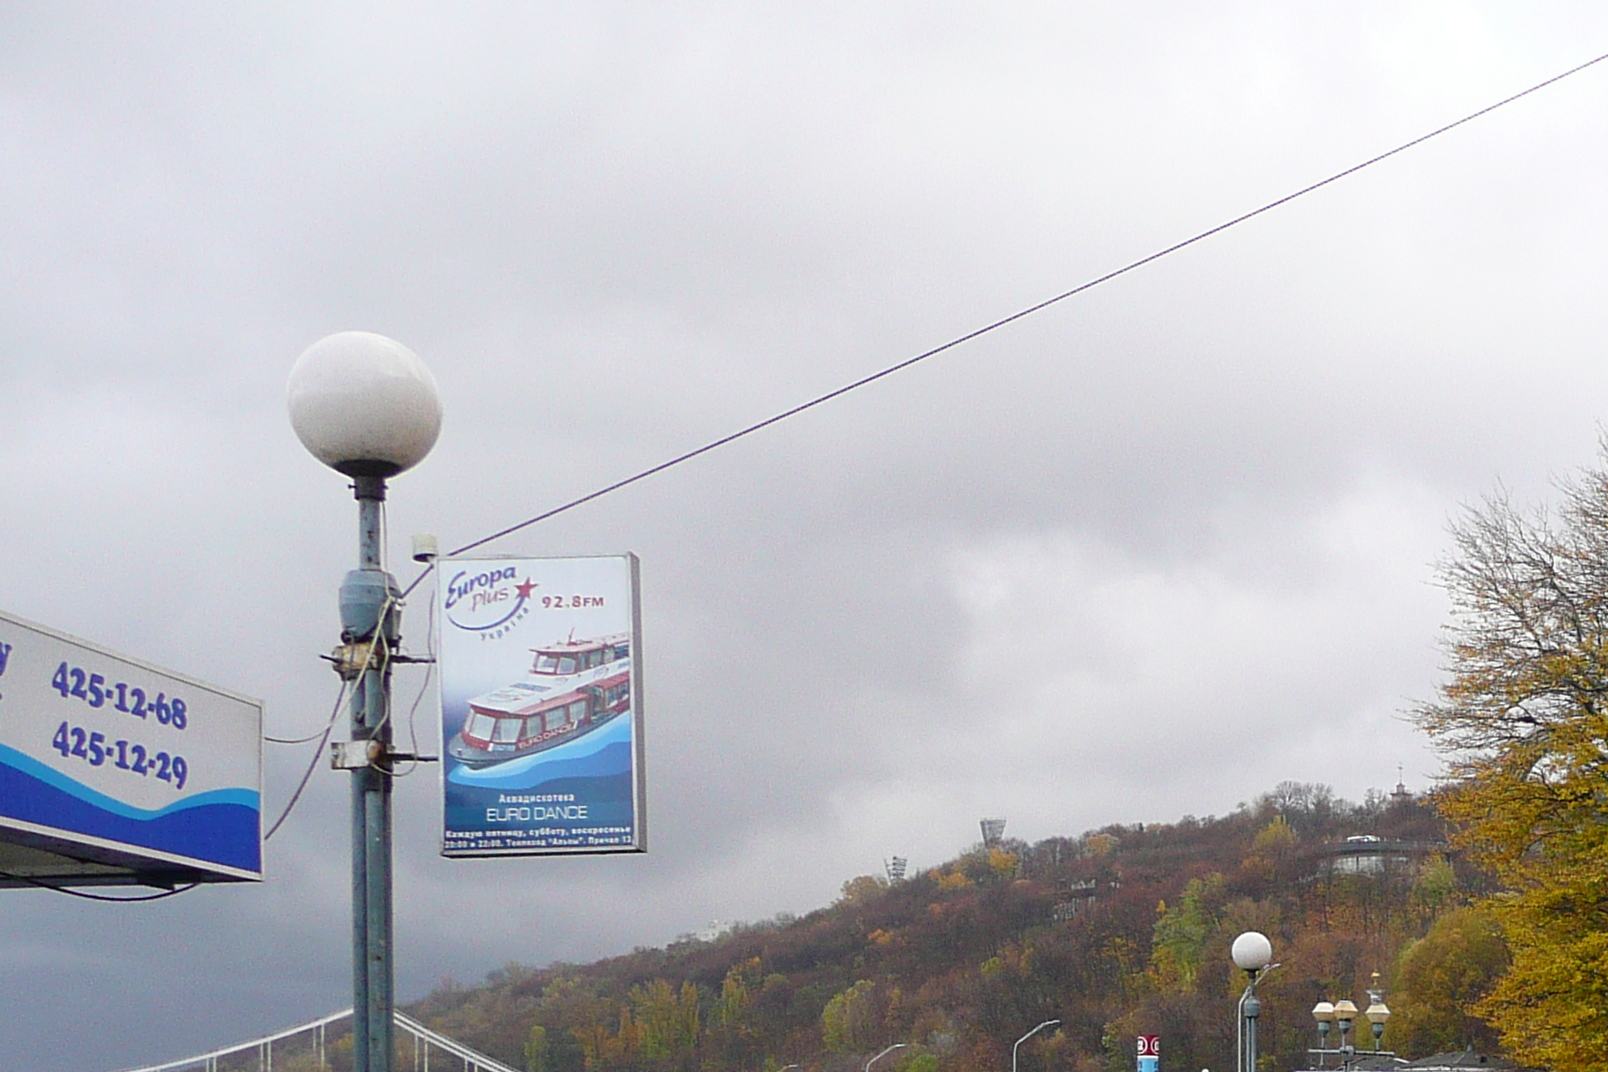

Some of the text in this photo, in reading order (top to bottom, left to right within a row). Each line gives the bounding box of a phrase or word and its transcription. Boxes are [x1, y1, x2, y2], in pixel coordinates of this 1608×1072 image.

[445, 566, 516, 609] Europa
[470, 588, 509, 612] plus
[52, 661, 188, 730] 425-12-68
[52, 721, 188, 790] 425-12-29
[486, 805, 588, 822] EURO DANCE
[499, 794, 575, 804] Аквадискотека
